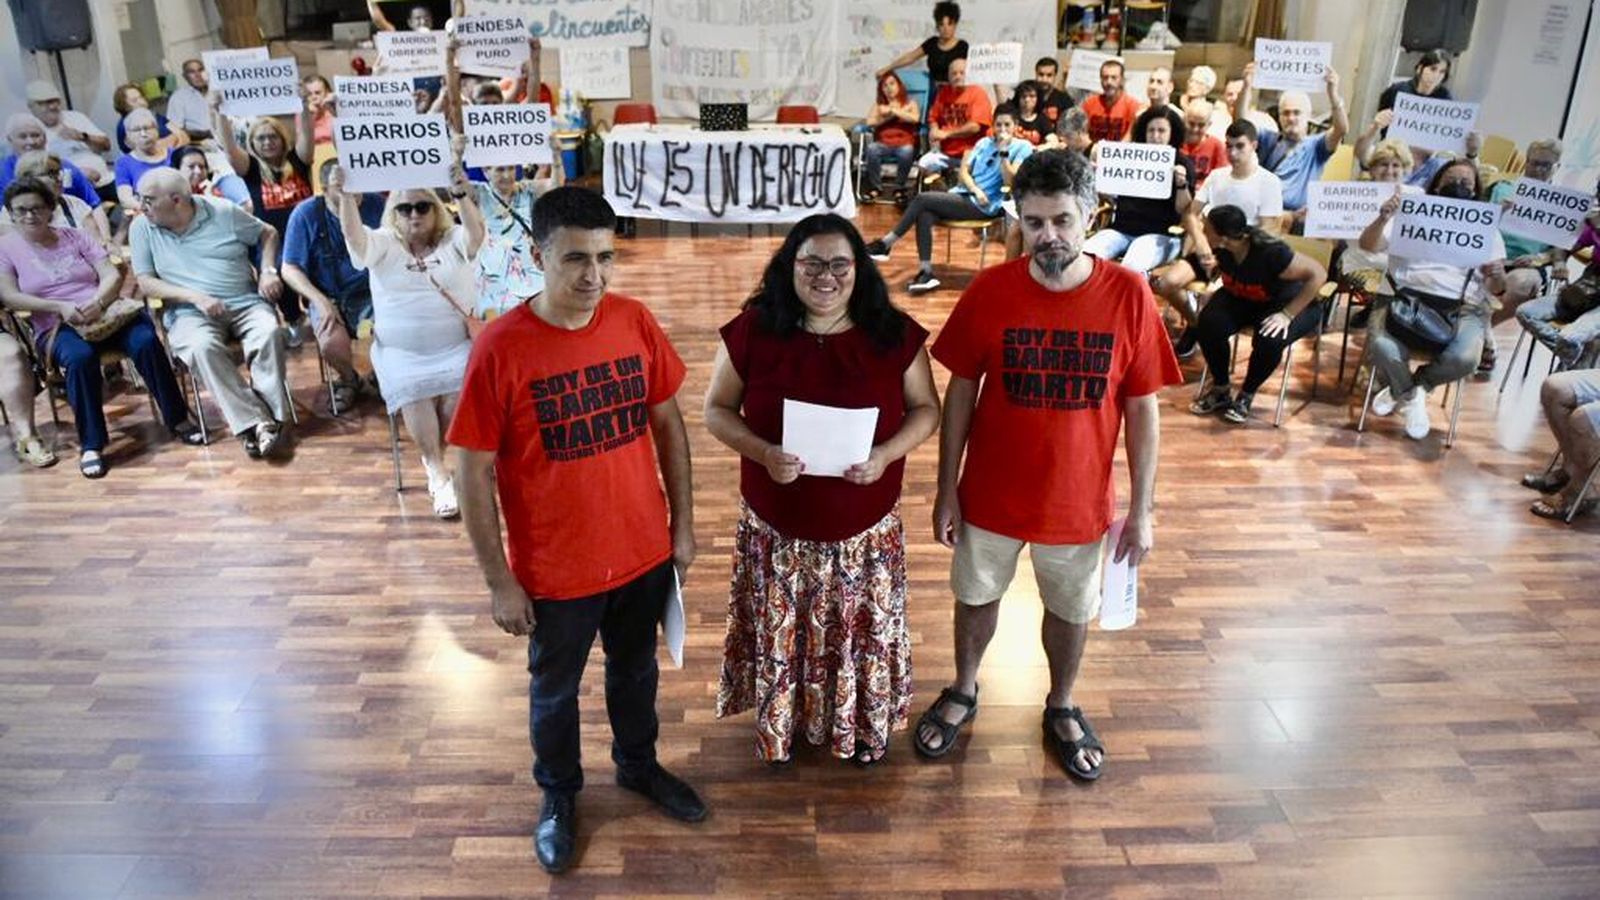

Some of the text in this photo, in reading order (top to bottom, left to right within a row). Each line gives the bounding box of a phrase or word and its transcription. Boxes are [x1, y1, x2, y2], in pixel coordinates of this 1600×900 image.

[457, 18, 525, 34] #ENDESA
[529, 4, 651, 39] elincuentes
[476, 48, 511, 58] PURO
[1265, 45, 1282, 54] NO
[1284, 46, 1293, 55] A
[217, 65, 293, 81] BARRIOS
[1260, 59, 1324, 75] CORTES
[224, 84, 293, 101] HARTOS
[339, 81, 411, 94] #ENDESA
[340, 99, 413, 109] CAPITALISMO
[1399, 99, 1474, 121] BARRIOS
[468, 110, 547, 126] BARRIOS
[1397, 117, 1464, 139] HARTOS
[341, 122, 441, 141] BARRIOS
[473, 133, 545, 148] HARTOS
[349, 148, 441, 169] HARTOS
[1101, 147, 1170, 163] BARRIOS
[660, 140, 694, 208] ES
[705, 141, 744, 218] UN
[747, 142, 847, 212] DERECHO
[1103, 166, 1165, 182] HARTOS
[1323, 186, 1379, 197] BARRIOS
[1515, 183, 1590, 213] BARRIOS
[1318, 201, 1379, 212] OBREROS
[1401, 199, 1494, 226] BARRIOS
[1511, 203, 1578, 232] HARTOS
[1400, 223, 1484, 249] HARTOS
[1003, 328, 1114, 351] SOY DE UN
[1003, 348, 1112, 373] BARRIO
[531, 354, 642, 399] SOY DE UN
[1002, 373, 1108, 400] HARTO
[537, 375, 646, 424] BARRIO
[541, 402, 648, 451] HARTO
